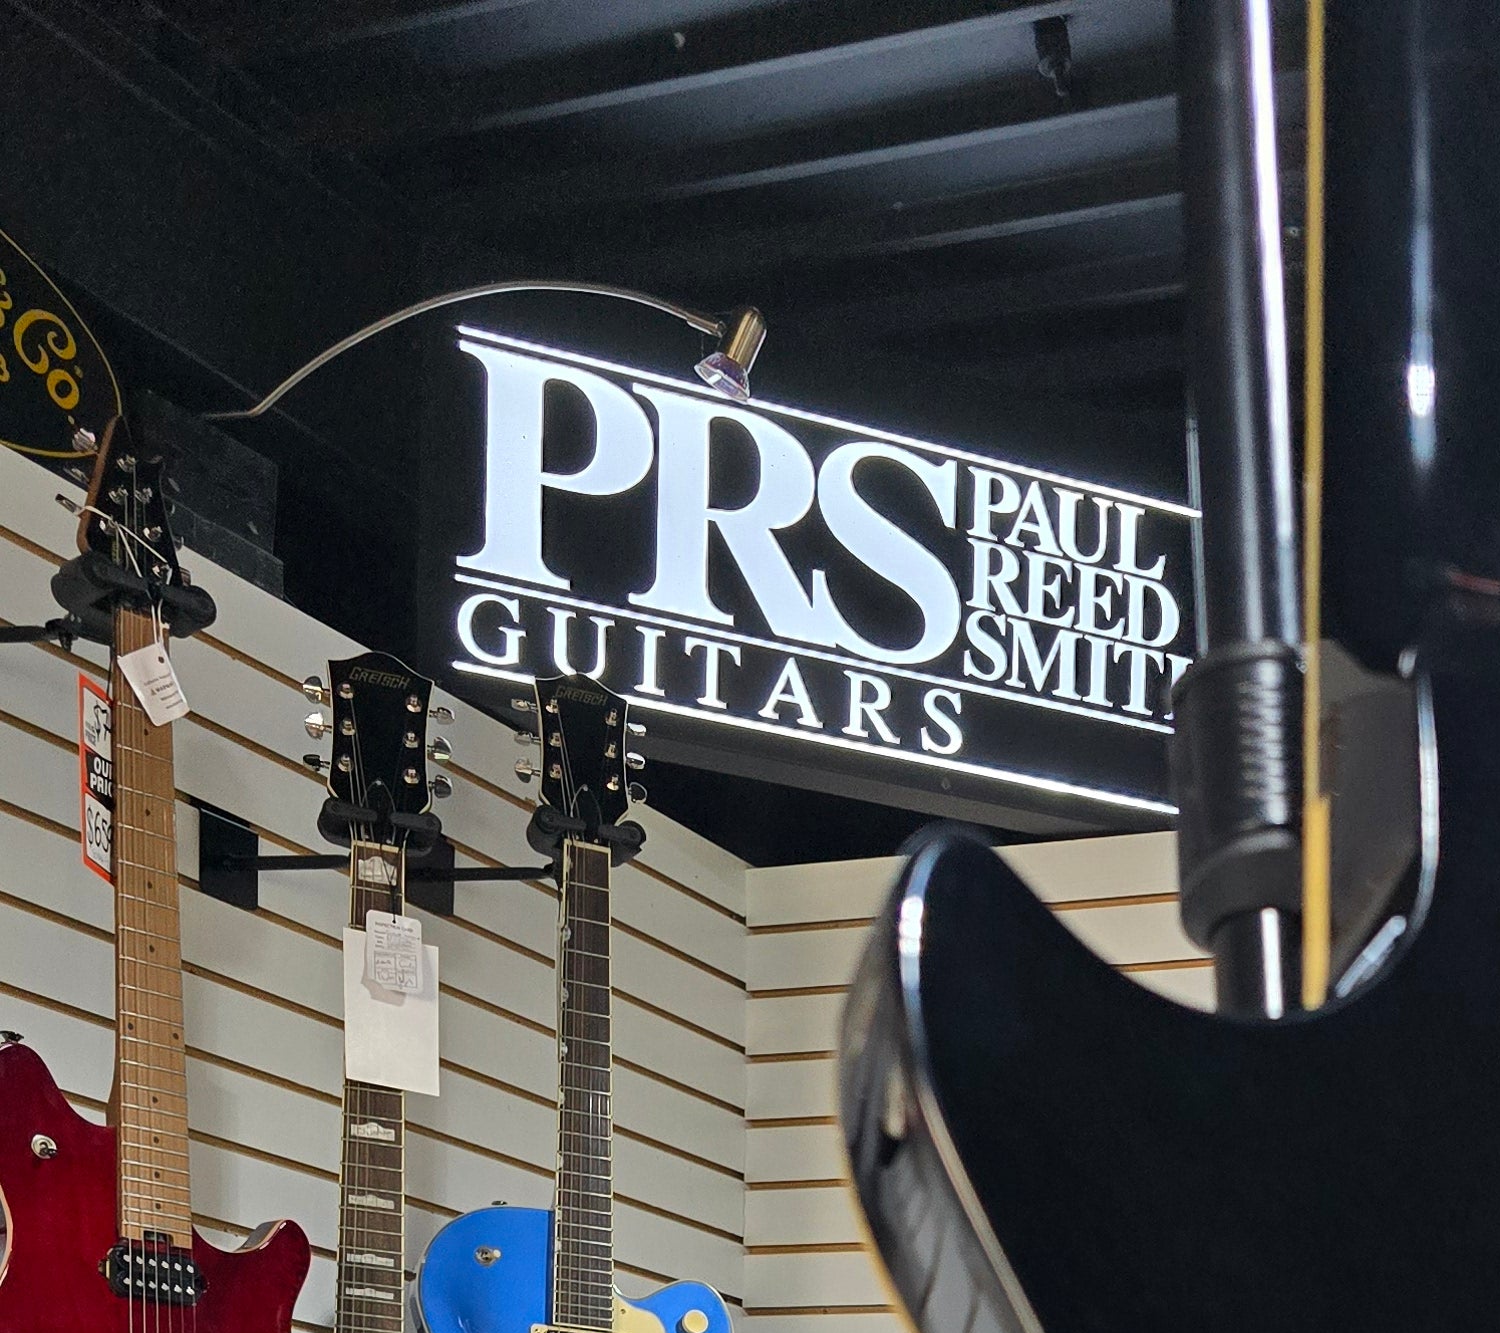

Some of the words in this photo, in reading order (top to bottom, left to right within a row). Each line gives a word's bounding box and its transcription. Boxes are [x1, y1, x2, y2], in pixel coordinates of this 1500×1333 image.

[456, 340, 962, 665] PRS
[966, 465, 1166, 580] PAUL
[965, 537, 1180, 648] REED
[349, 666, 410, 690] GRETSCH
[456, 593, 963, 755] GUITARS
